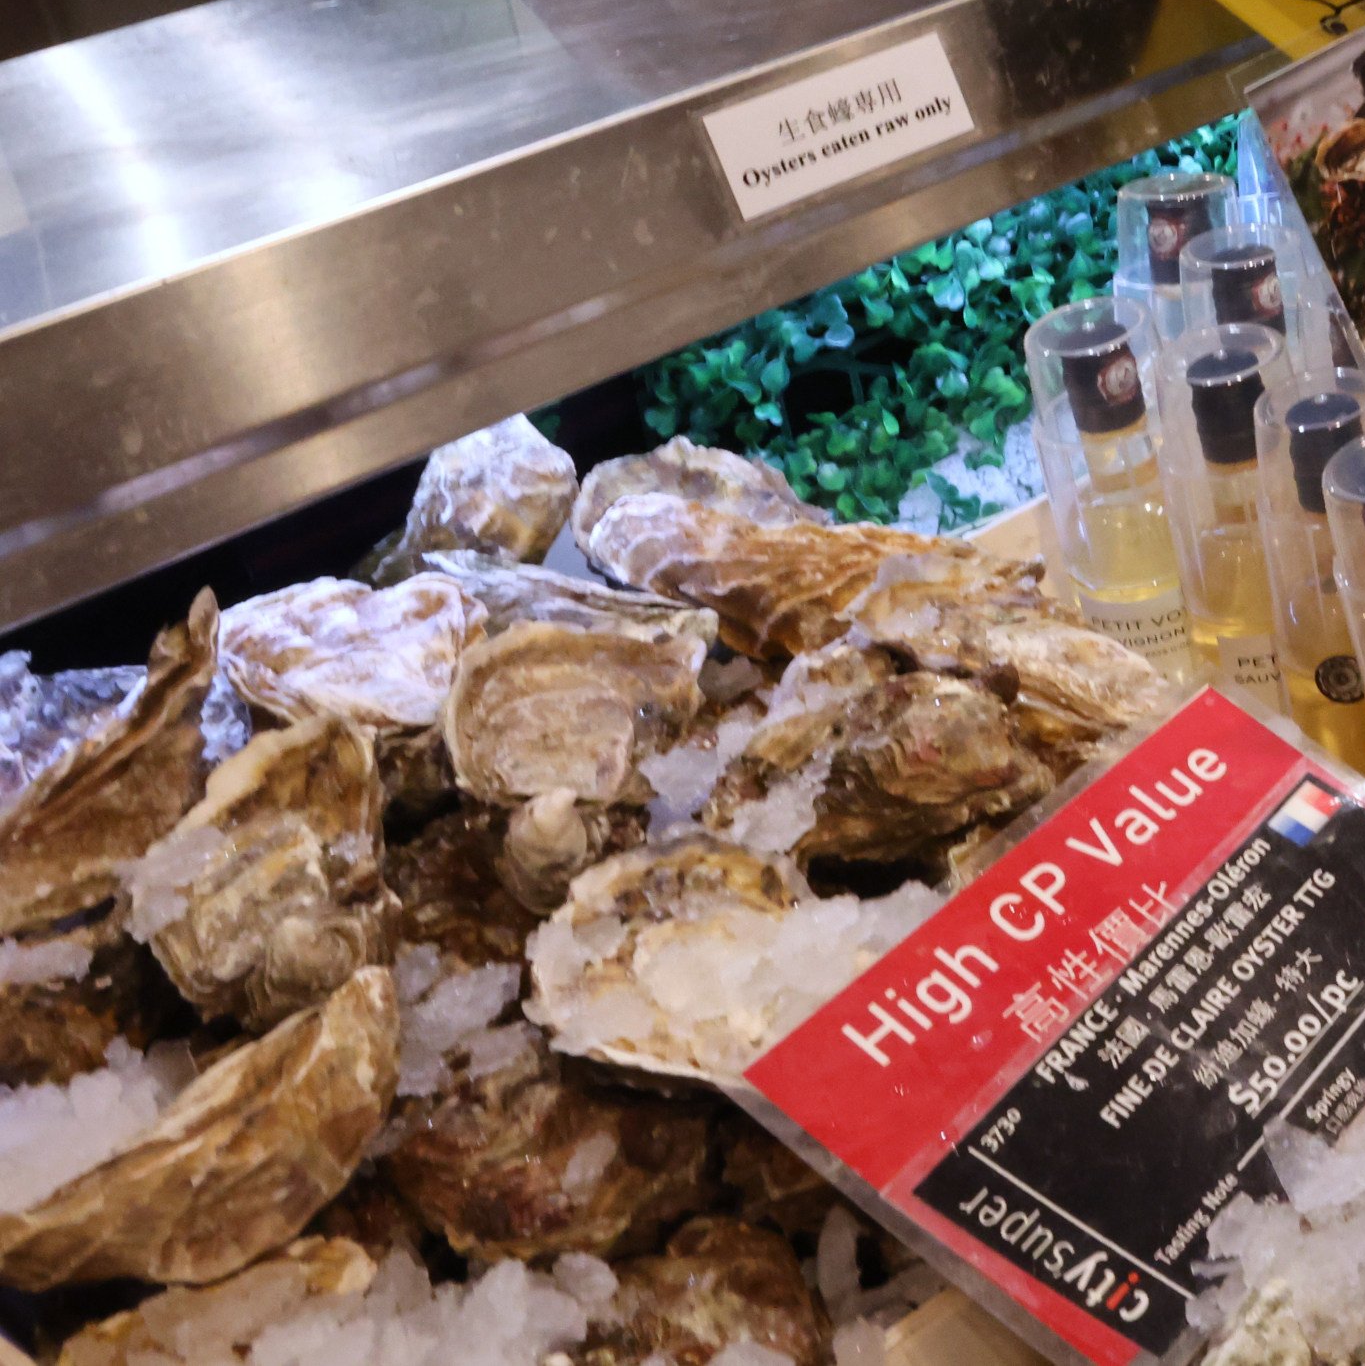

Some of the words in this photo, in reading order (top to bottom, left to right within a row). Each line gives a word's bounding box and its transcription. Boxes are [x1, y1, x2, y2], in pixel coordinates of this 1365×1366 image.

[740, 148, 818, 190] Oysters
[820, 128, 871, 158] eaten
[874, 114, 910, 136] raw
[912, 94, 953, 124] only
[775, 76, 904, 146] 生食蠔專用
[836, 936, 1008, 1073] High
[982, 858, 1080, 945] CP
[1062, 740, 1232, 872] Value
[997, 874, 1197, 1046] 高性價比
[1034, 1000, 1118, 1082] FRANCE
[1102, 836, 1278, 998] Marennes-Oléron
[1096, 1072, 1157, 1130] FINE
[1138, 1042, 1182, 1084] DE
[1164, 974, 1246, 1052] CLAIRE
[1226, 902, 1309, 982] OYSTER
[1290, 866, 1339, 910] TTG
[1092, 1014, 1154, 1071] 法國
[977, 1106, 1028, 1154] 3730
[1302, 1065, 1359, 1124] Springy
[1152, 1207, 1217, 1268] Tasting
[1200, 1172, 1242, 1212] Note
